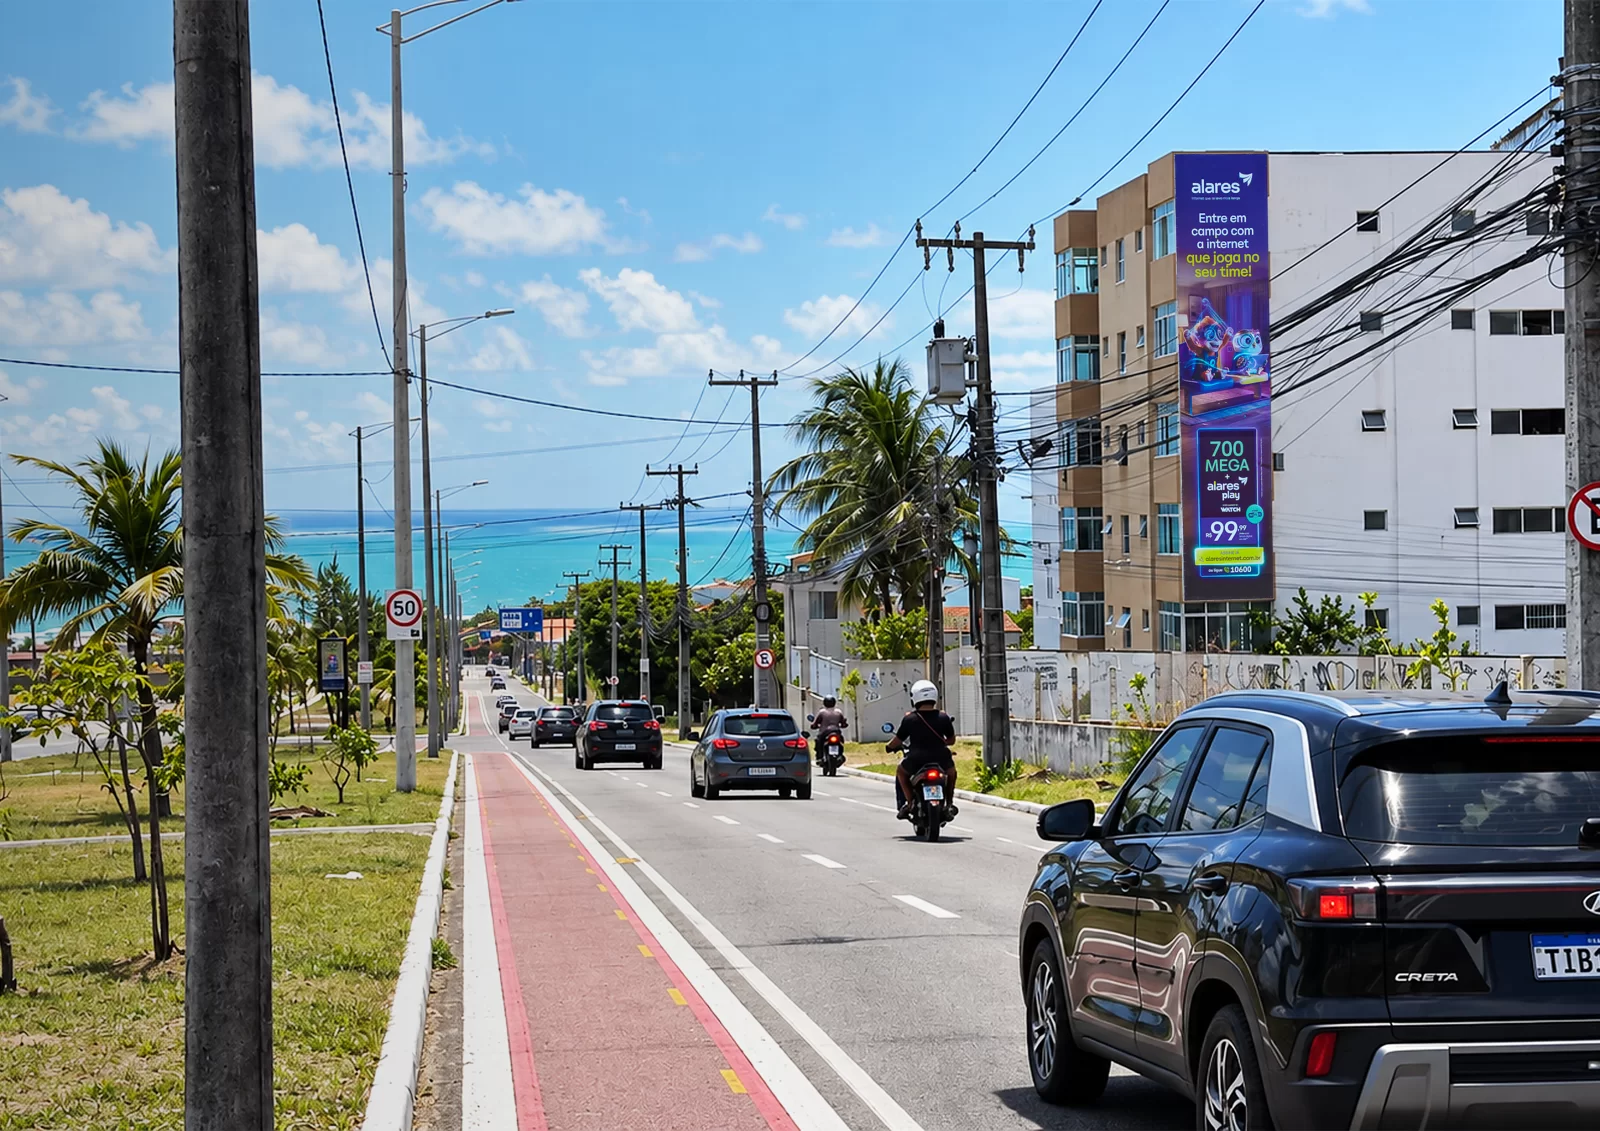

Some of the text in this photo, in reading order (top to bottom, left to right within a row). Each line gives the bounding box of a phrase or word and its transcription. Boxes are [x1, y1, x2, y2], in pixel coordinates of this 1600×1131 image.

[1191, 179, 1240, 194] alares
[1198, 212, 1246, 224] Entre em
[1191, 226, 1254, 238] campo com
[1196, 238, 1250, 249] a internet
[1186, 250, 1260, 267] que joga no
[1194, 265, 1252, 278] seu time!
[1210, 440, 1244, 457] 700
[1205, 459, 1250, 472] MEGA
[1207, 481, 1240, 491] alares
[1221, 490, 1240, 501] play
[393, 600, 415, 617] 50
[1394, 972, 1459, 982] CRETA
